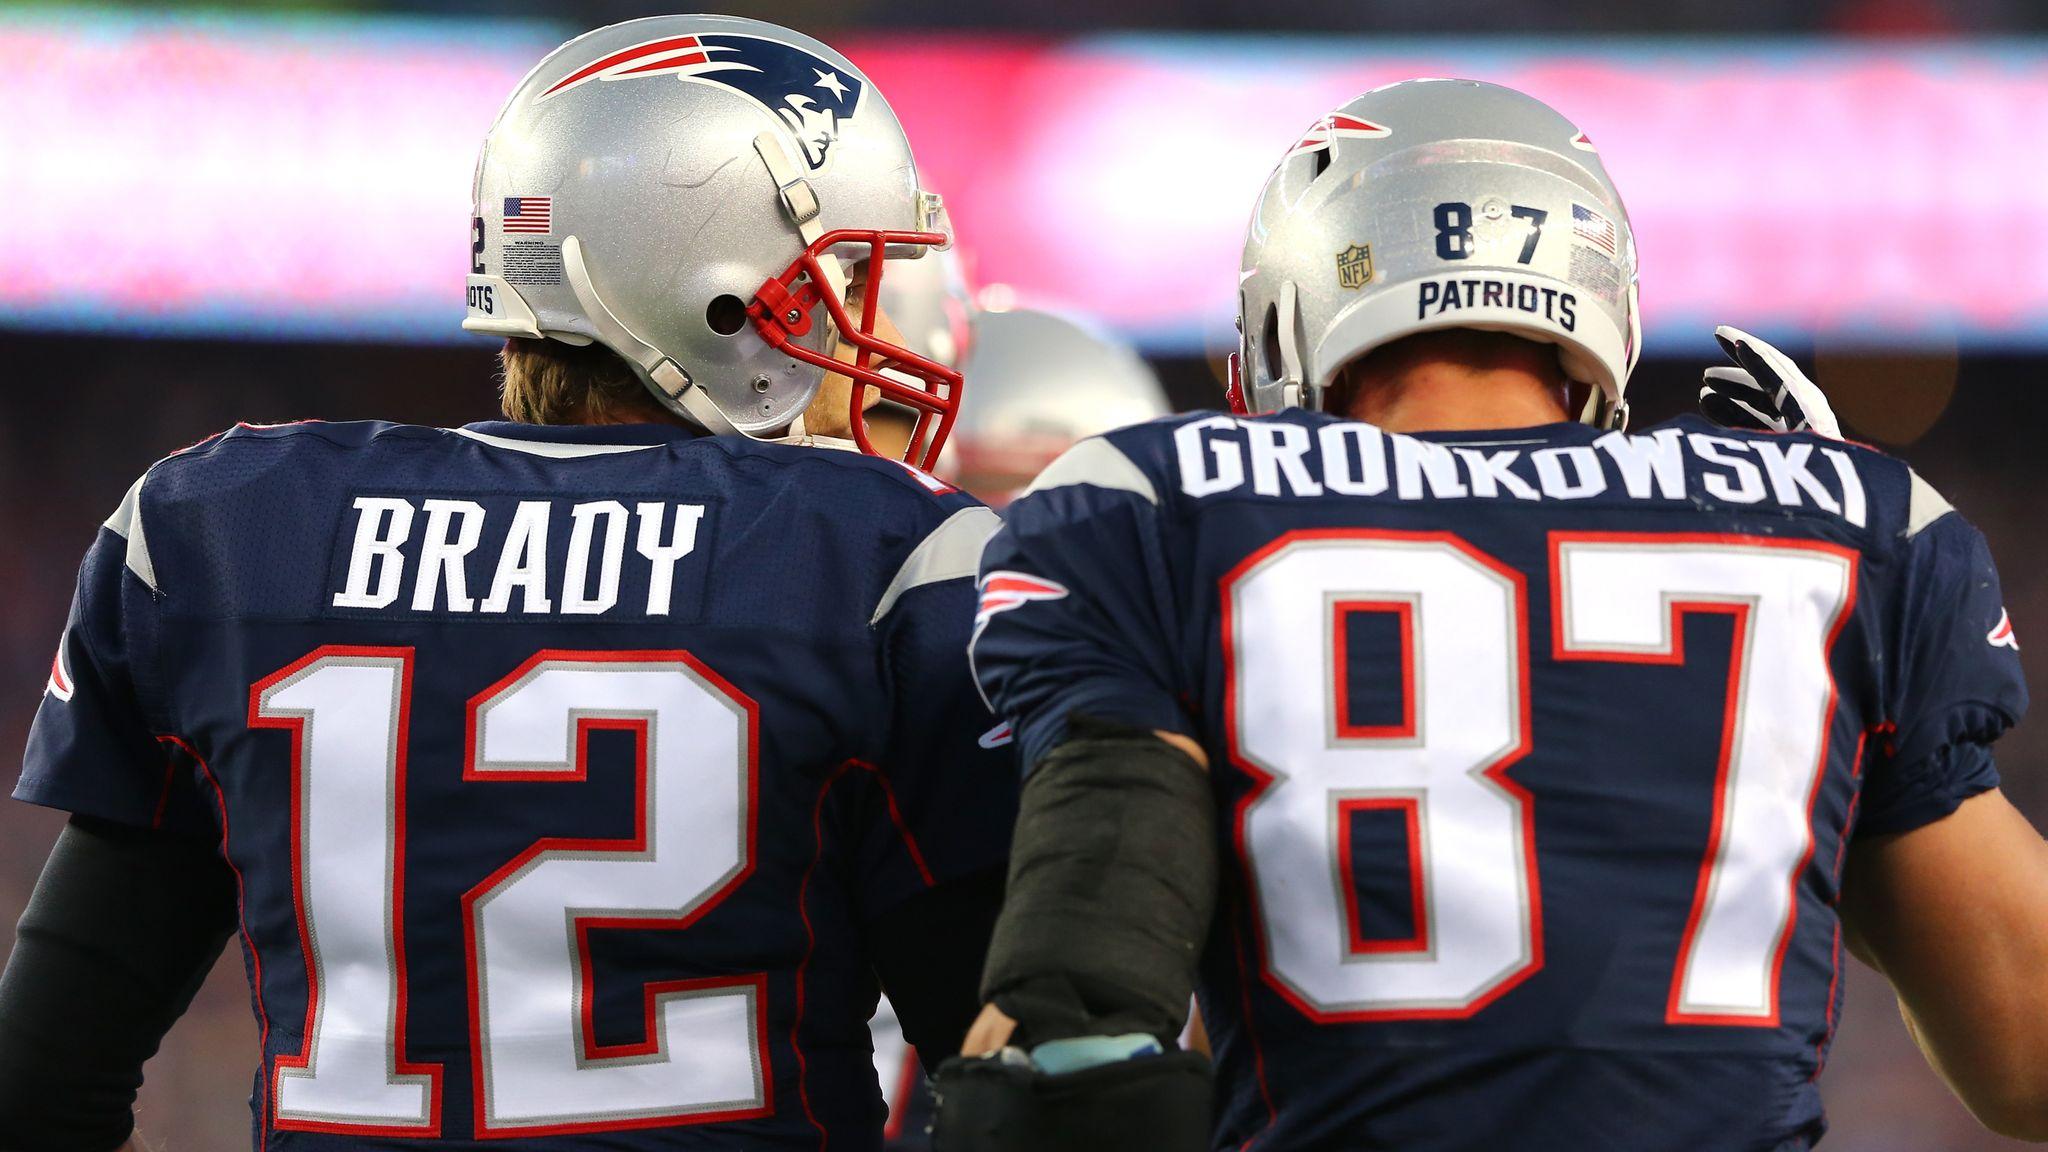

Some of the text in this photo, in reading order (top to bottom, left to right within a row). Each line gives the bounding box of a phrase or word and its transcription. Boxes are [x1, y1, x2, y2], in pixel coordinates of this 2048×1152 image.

[1341, 262, 1370, 285] NFL
[1433, 202, 1548, 265] 87
[1418, 280, 1577, 332] PATRIOTS
[1173, 415, 1867, 528] GRONKOWSKI
[333, 496, 705, 616] BRADY
[1218, 528, 1860, 1027] 87
[247, 644, 774, 1140] 12
